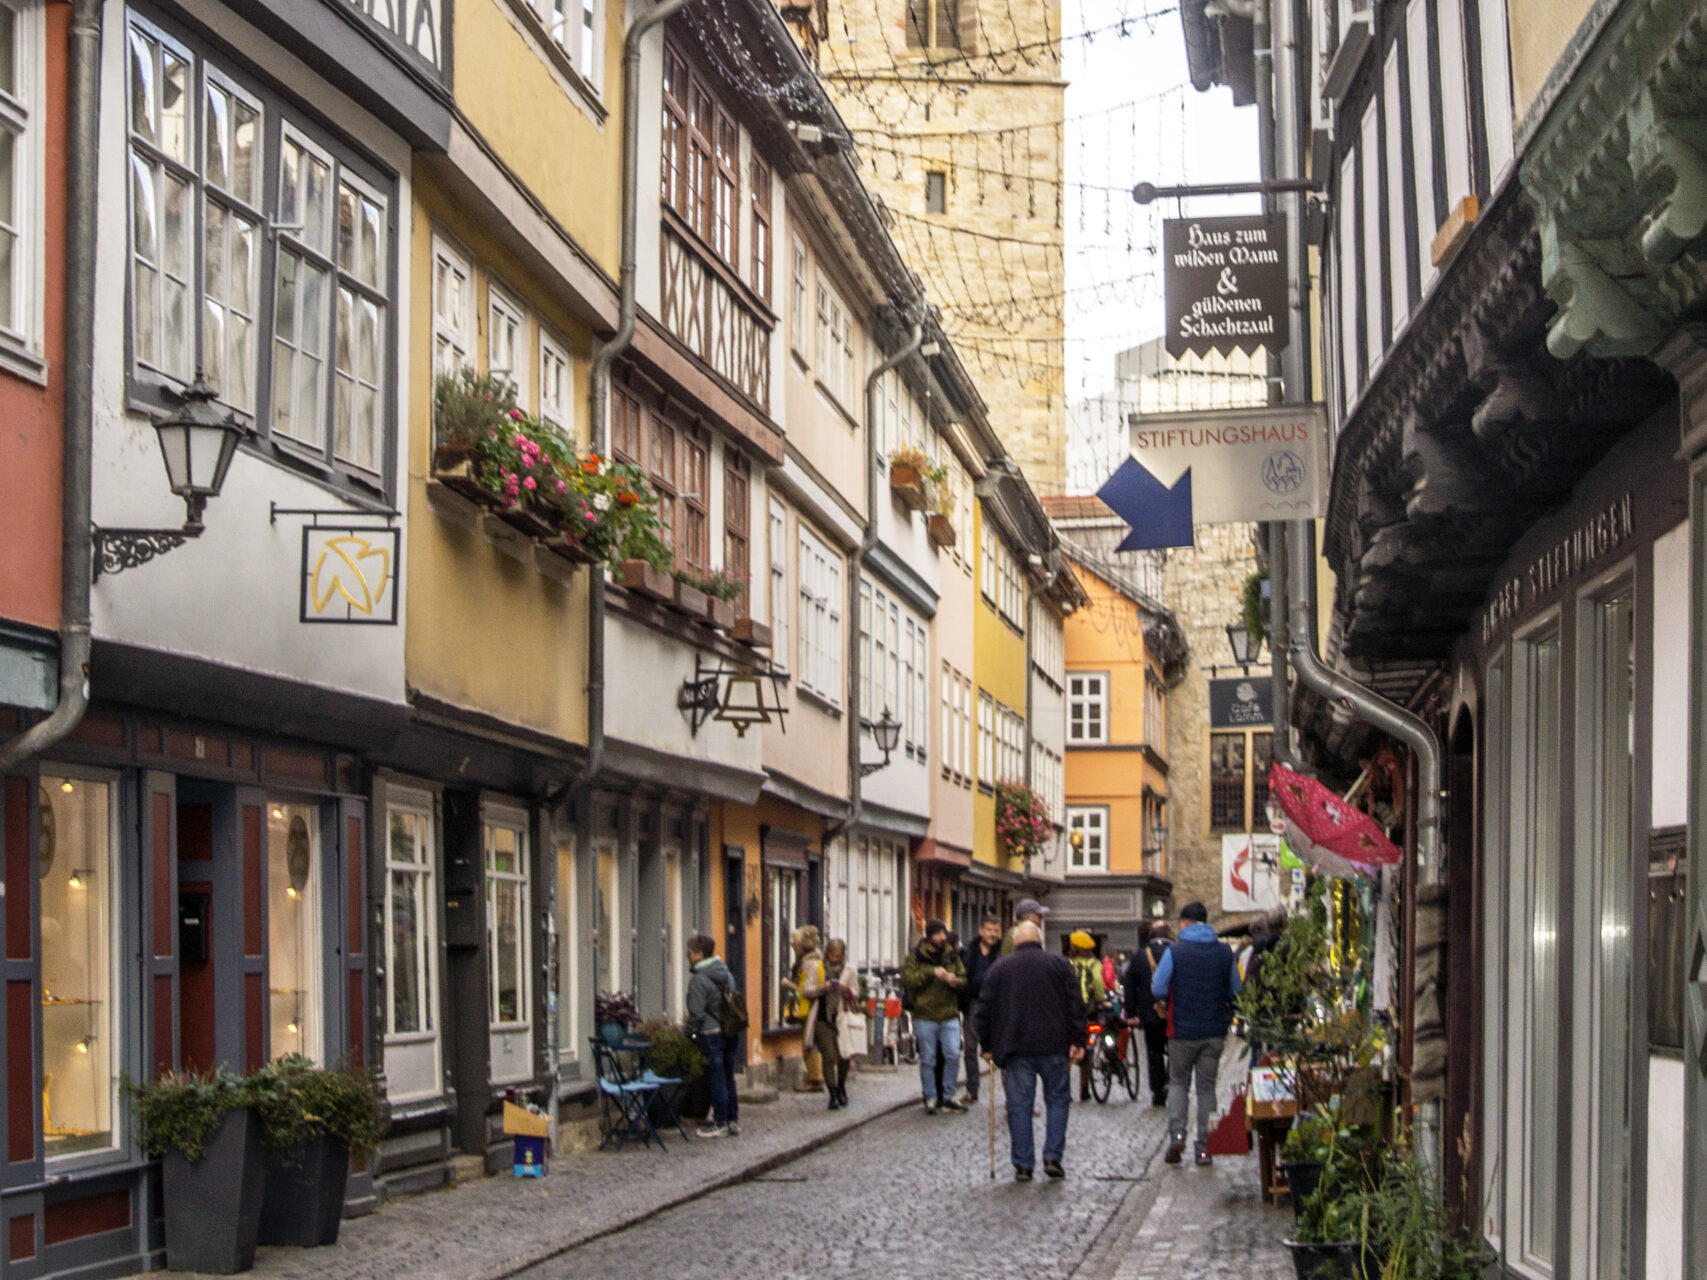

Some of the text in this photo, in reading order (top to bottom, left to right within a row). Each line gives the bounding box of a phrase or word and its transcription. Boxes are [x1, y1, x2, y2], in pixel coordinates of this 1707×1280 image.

[1188, 223, 1268, 249] Haus zum
[1174, 246, 1279, 268] wilden Mann
[1216, 266, 1239, 295] &
[1191, 296, 1263, 318] güldenen
[1179, 314, 1275, 338] Schachtzaul
[1138, 422, 1308, 449] STIFTUNGSHAUS
[1528, 491, 1632, 601] STIFTUNGEN
